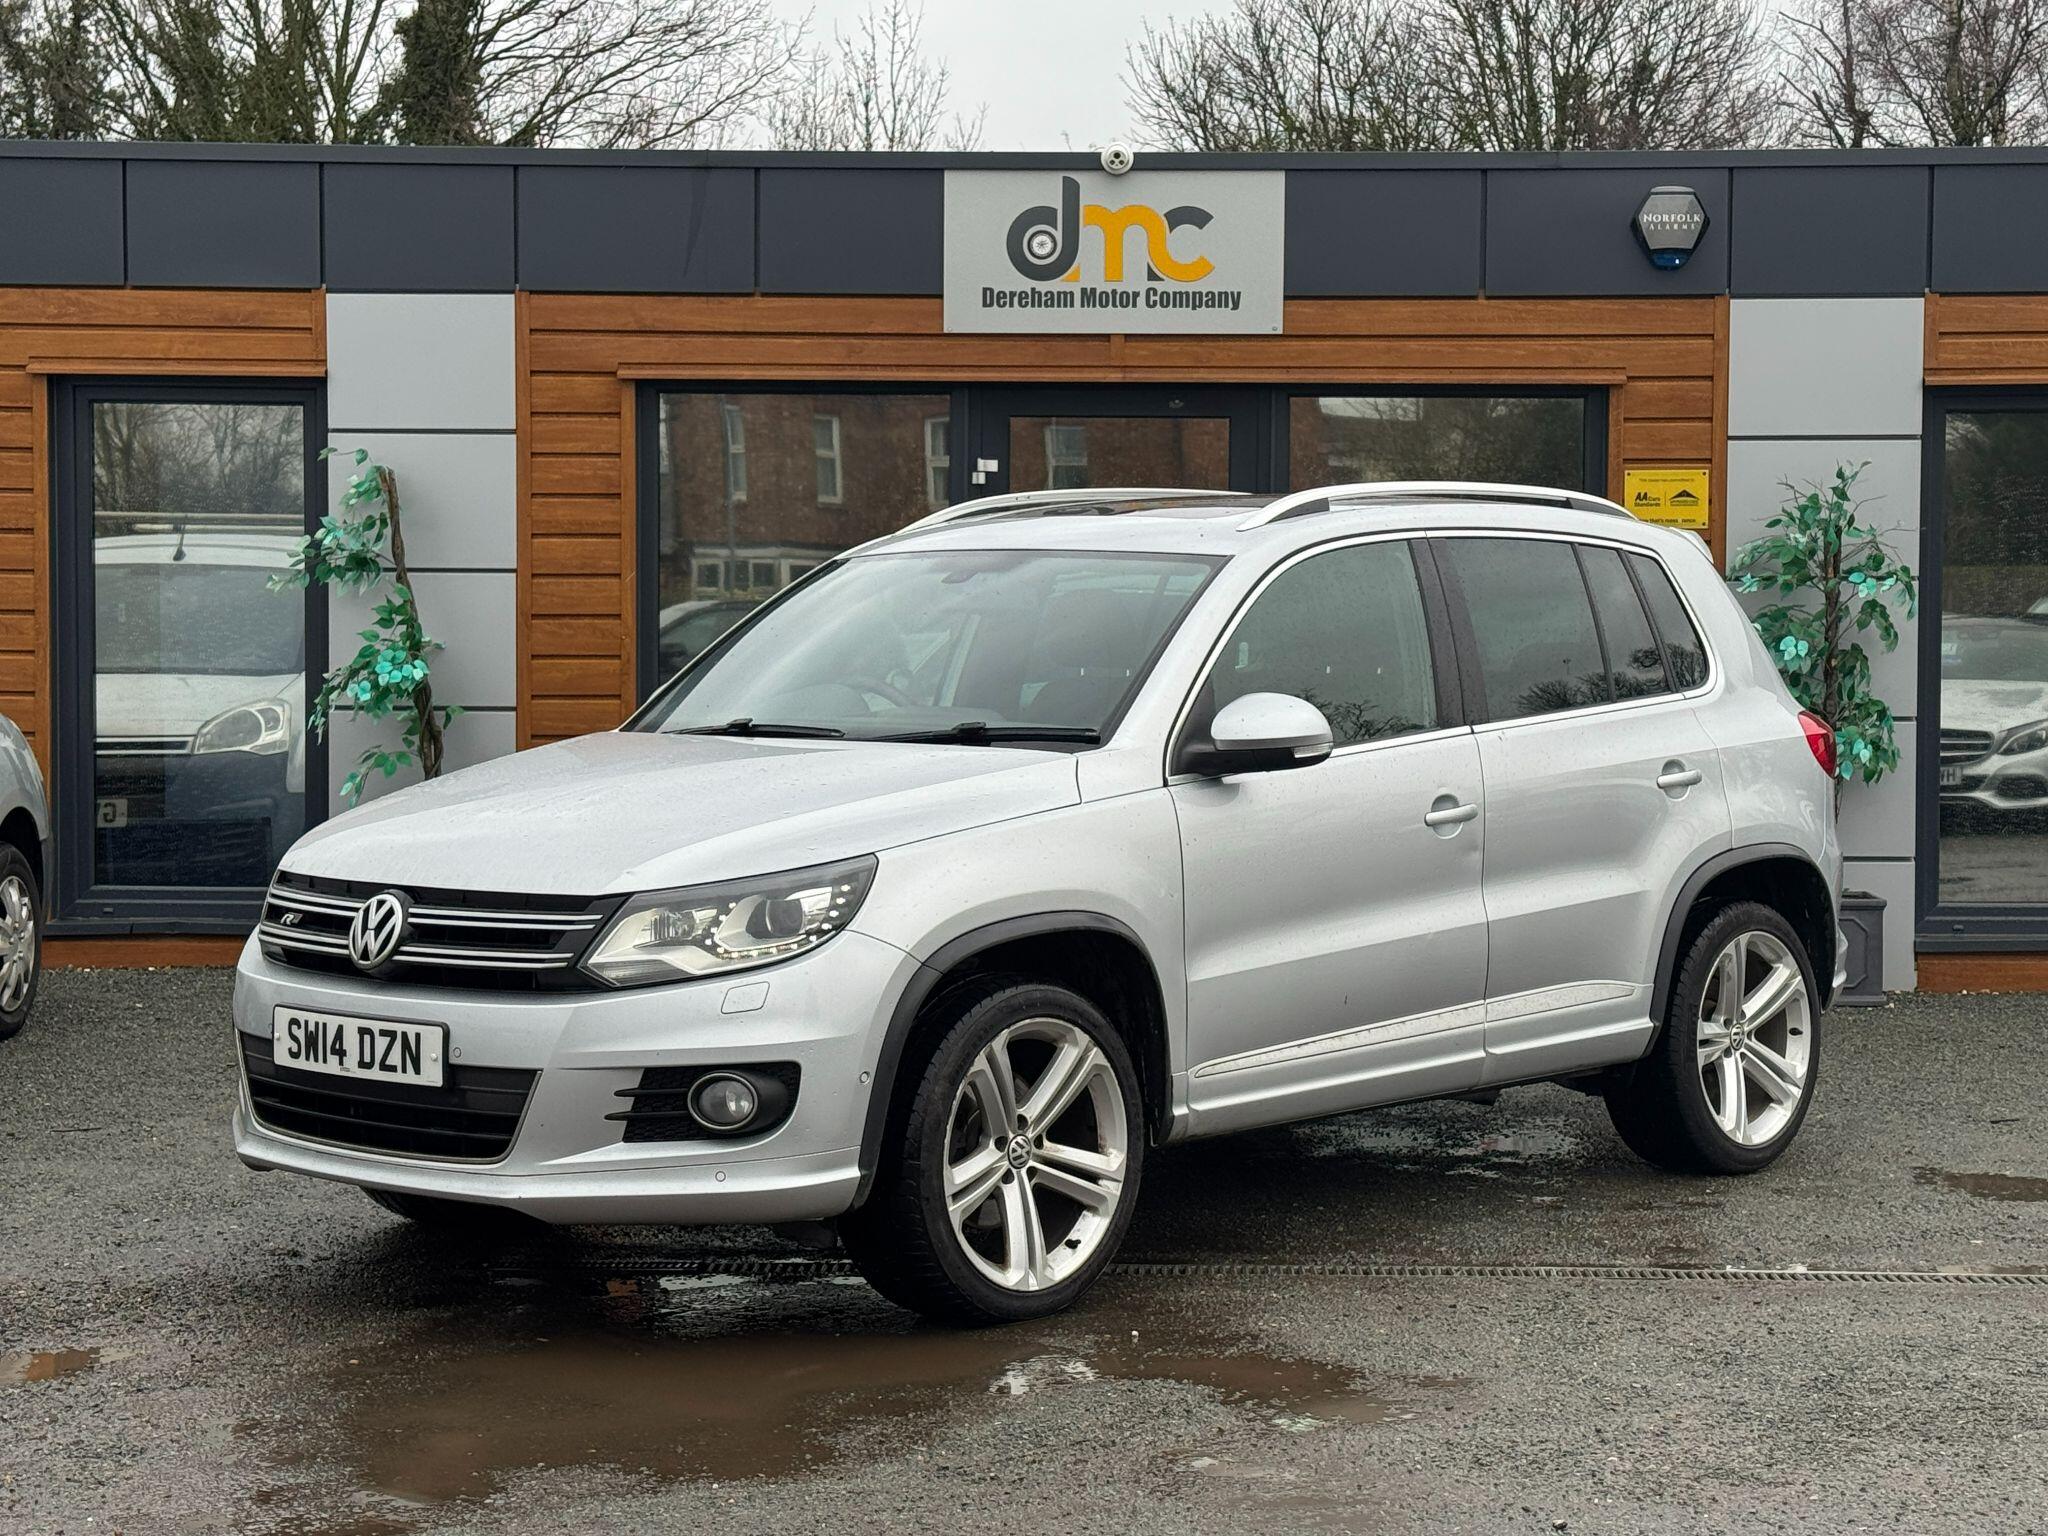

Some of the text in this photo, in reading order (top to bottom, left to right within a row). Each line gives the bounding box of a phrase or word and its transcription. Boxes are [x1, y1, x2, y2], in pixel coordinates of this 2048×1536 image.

[1006, 175, 1215, 282] dmc
[1643, 213, 1701, 222] NORFOLK
[982, 287, 1241, 310] Dereham Motor Company
[1634, 492, 1648, 501] AA
[288, 1017, 421, 1075] SW14 DZN
